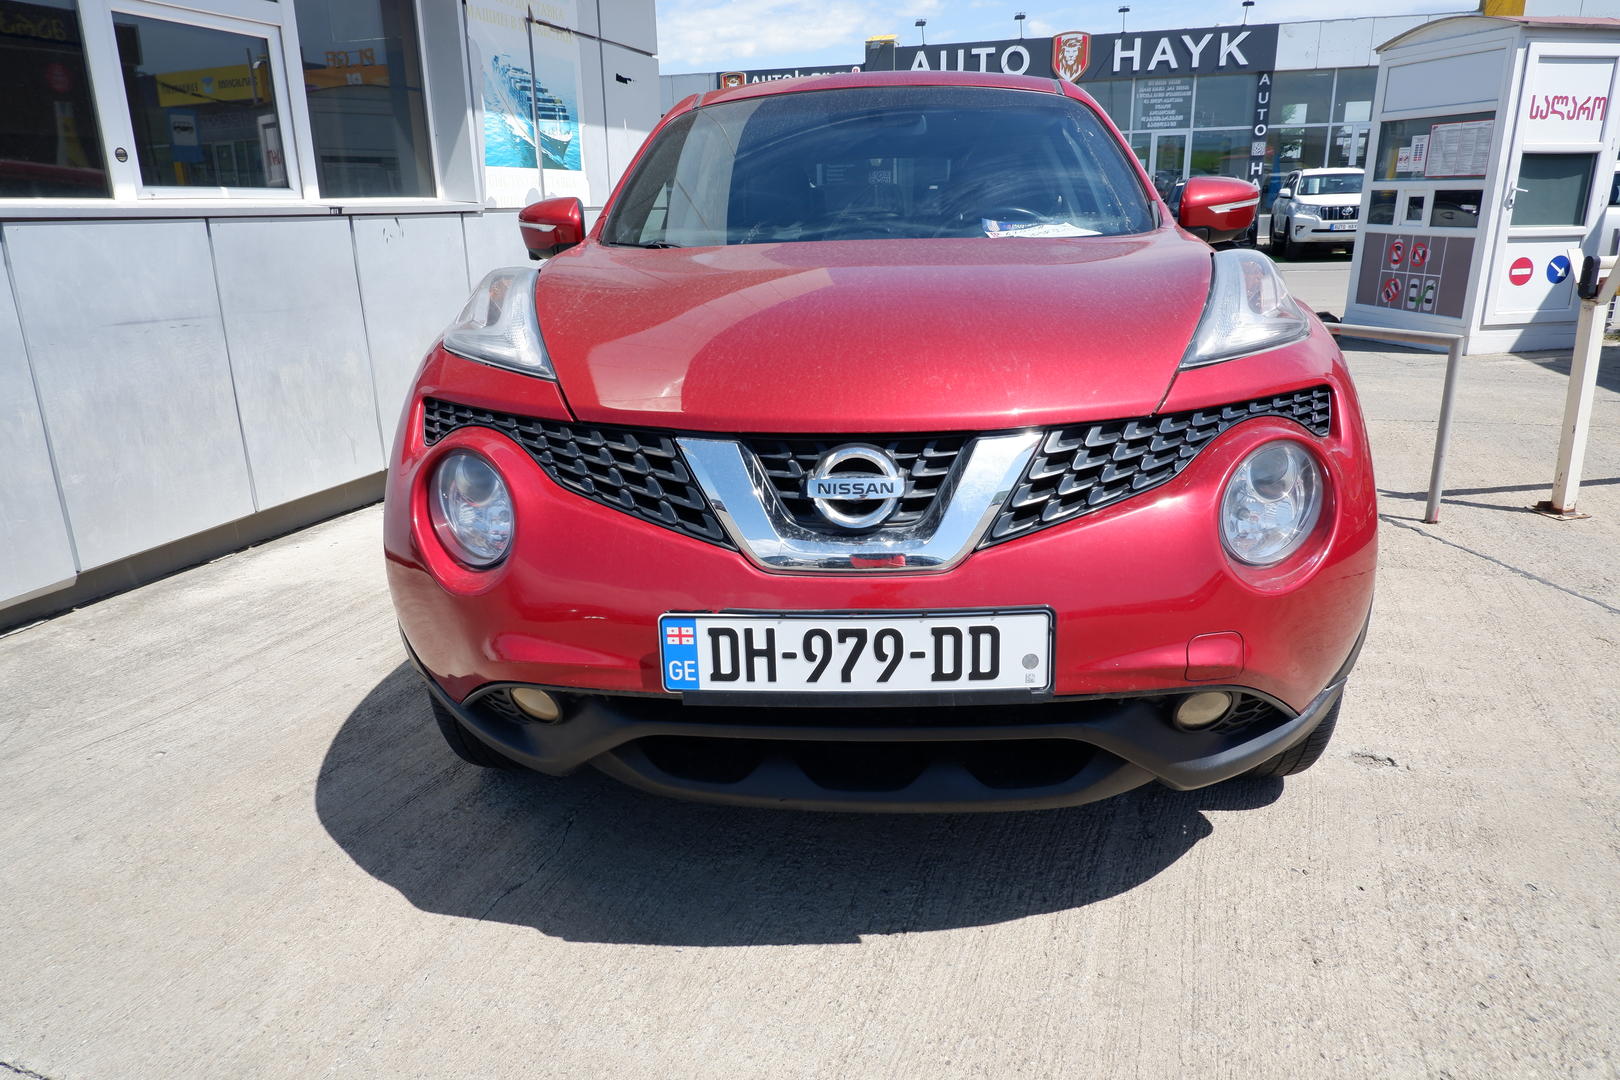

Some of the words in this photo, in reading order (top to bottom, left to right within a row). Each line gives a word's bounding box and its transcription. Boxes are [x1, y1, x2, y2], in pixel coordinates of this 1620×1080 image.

[910, 45, 1031, 76] AUTO
[1112, 31, 1253, 73] HAYK
[1254, 73, 1271, 136] AUTO
[1529, 94, 1607, 121] სალარო
[1250, 162, 1263, 190] HA
[817, 482, 894, 495] NISSAN
[707, 625, 1000, 683] DH-979-DD
[669, 660, 697, 681] GE
